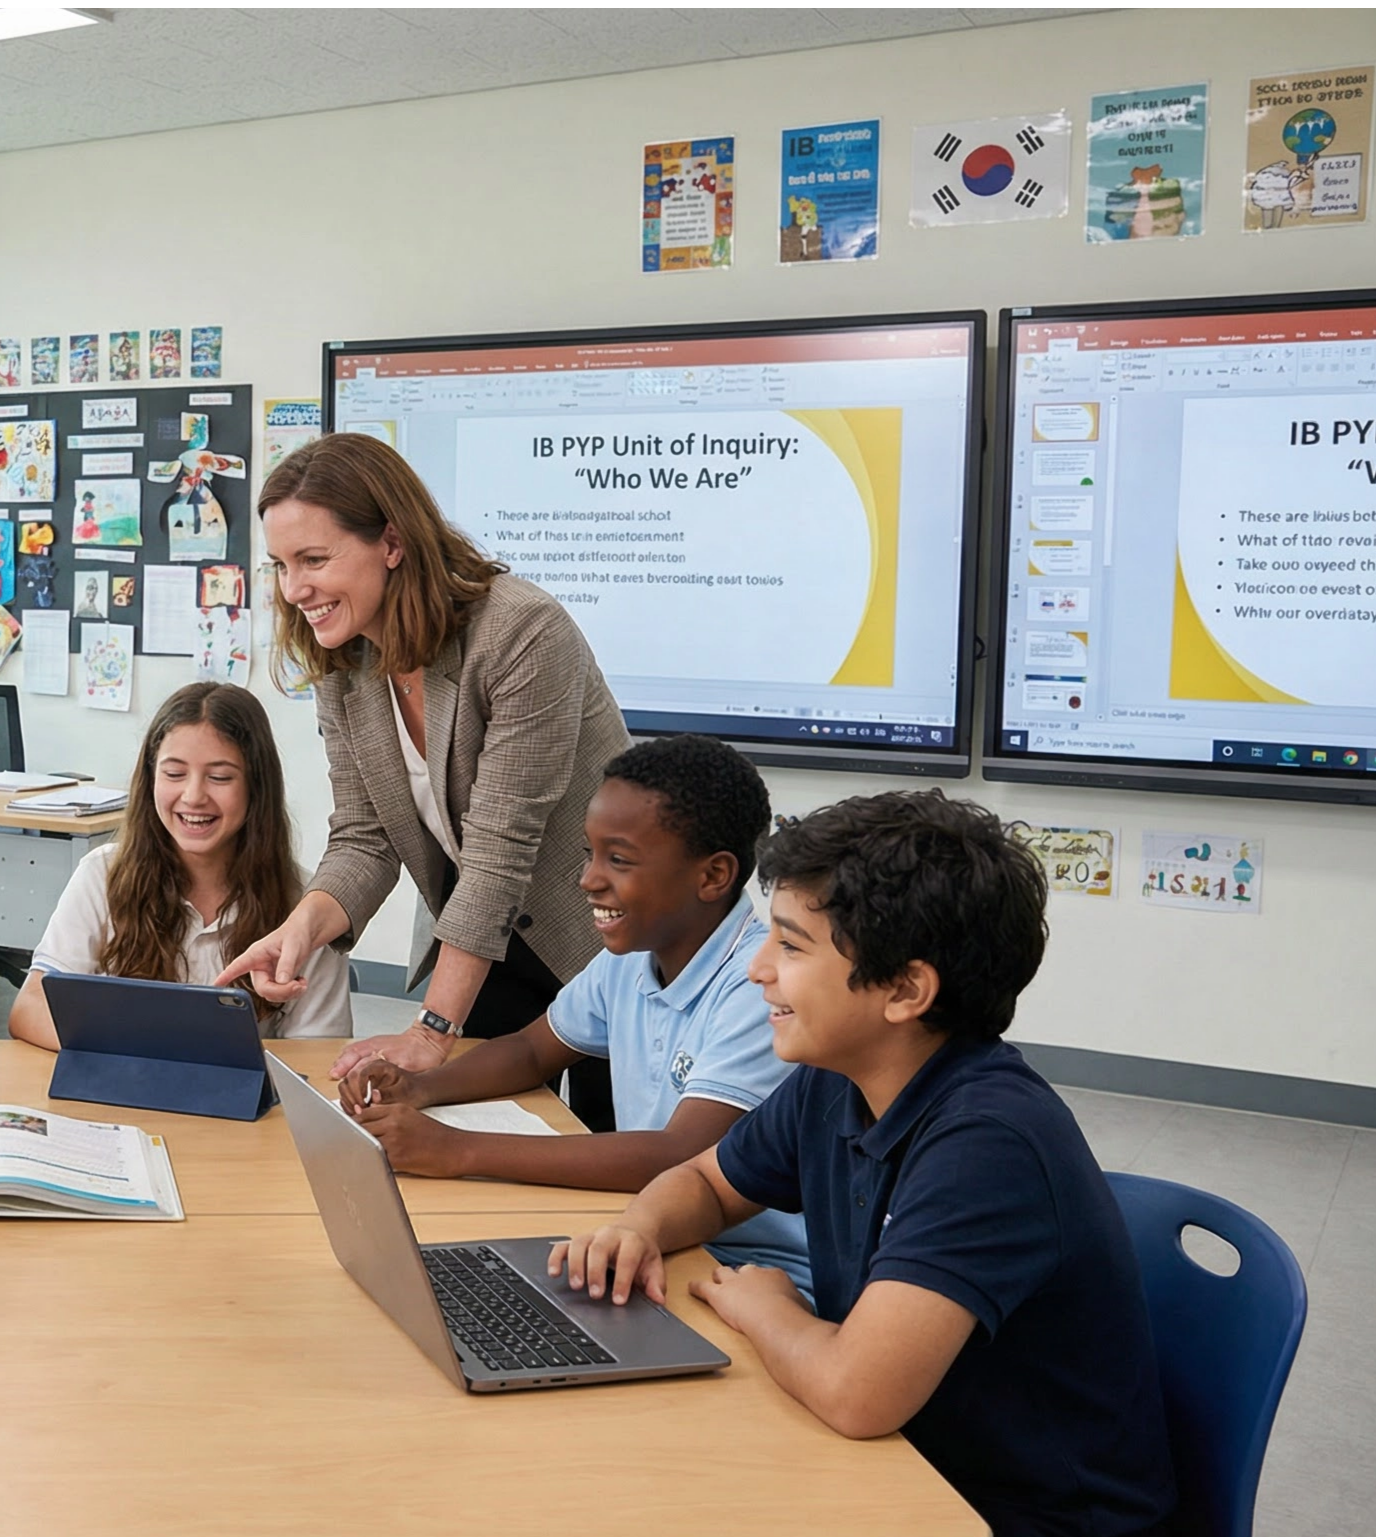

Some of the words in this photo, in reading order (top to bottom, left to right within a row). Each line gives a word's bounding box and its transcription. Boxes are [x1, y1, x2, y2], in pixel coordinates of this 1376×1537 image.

[789, 136, 815, 157] IB
[1290, 420, 1321, 446] IB
[1332, 419, 1376, 445] PY
[532, 437, 554, 458] IB
[562, 436, 605, 457] PYP
[613, 434, 663, 457] Unit
[670, 433, 695, 455] of
[703, 433, 799, 460] Inquiry:
[649, 468, 688, 489] We
[532, 512, 549, 520] are
[1239, 510, 1281, 522] These
[1285, 512, 1309, 522] are
[496, 530, 524, 541] What
[1237, 534, 1278, 546] What
[1282, 533, 1298, 546] of
[1236, 558, 1267, 570] Take
